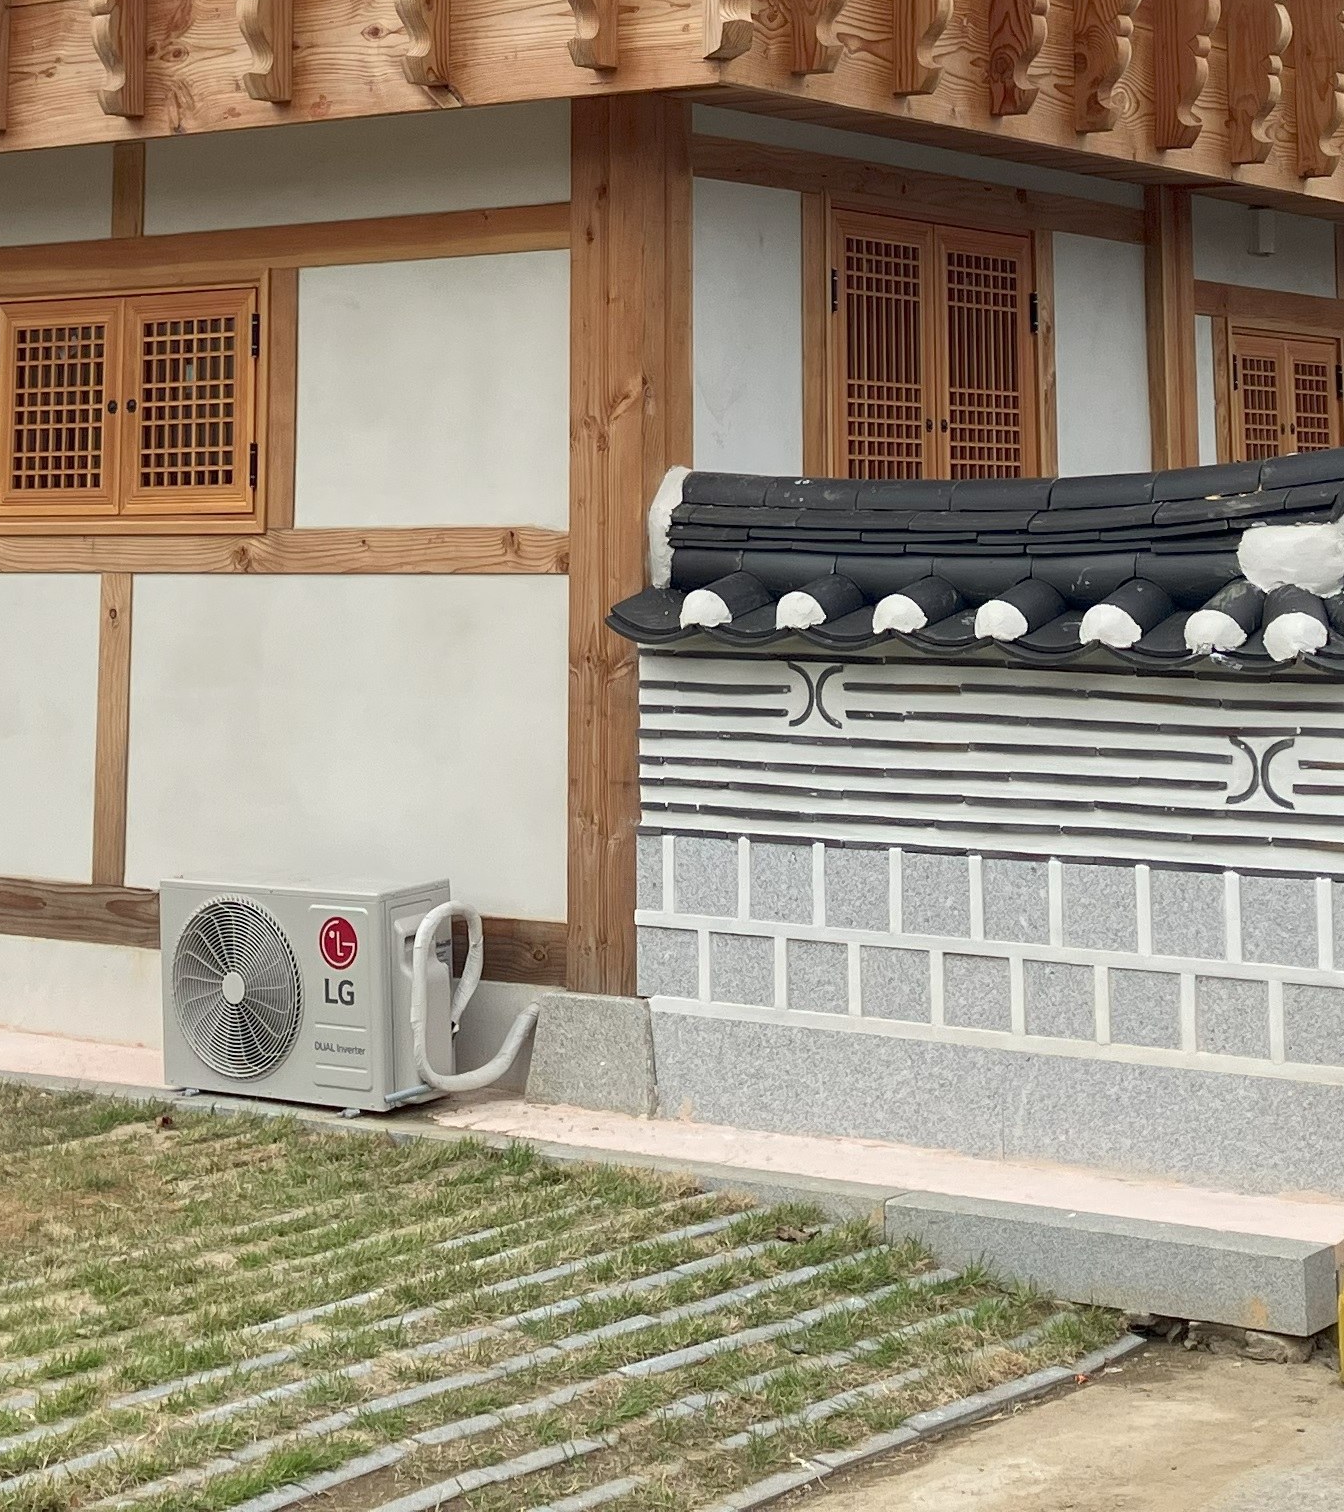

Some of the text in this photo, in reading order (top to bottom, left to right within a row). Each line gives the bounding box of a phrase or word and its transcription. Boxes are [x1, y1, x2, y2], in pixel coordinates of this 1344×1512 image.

[324, 978, 355, 1006] LG
[314, 1041, 366, 1055] DUAL Inverter
